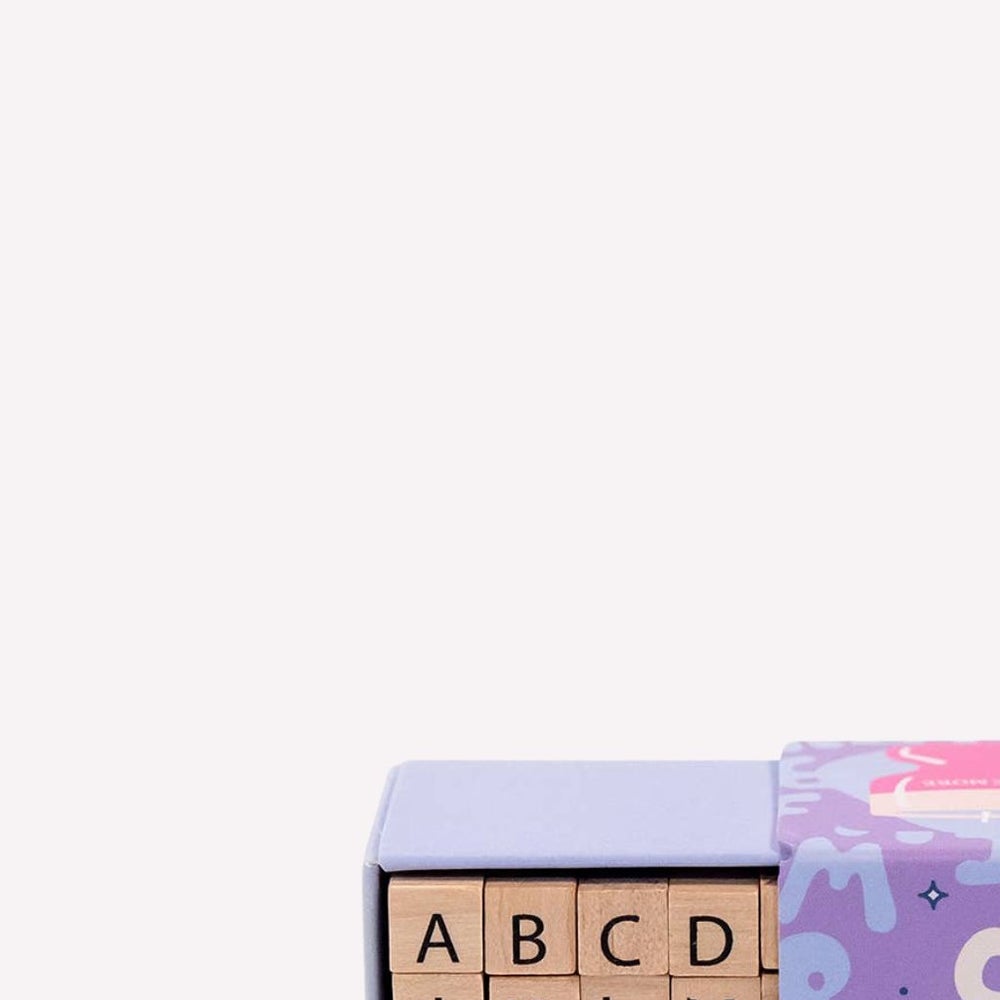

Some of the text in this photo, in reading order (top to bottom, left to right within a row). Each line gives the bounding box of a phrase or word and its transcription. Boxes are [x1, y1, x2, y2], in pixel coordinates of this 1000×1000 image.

[416, 913, 733, 967] A B C D
